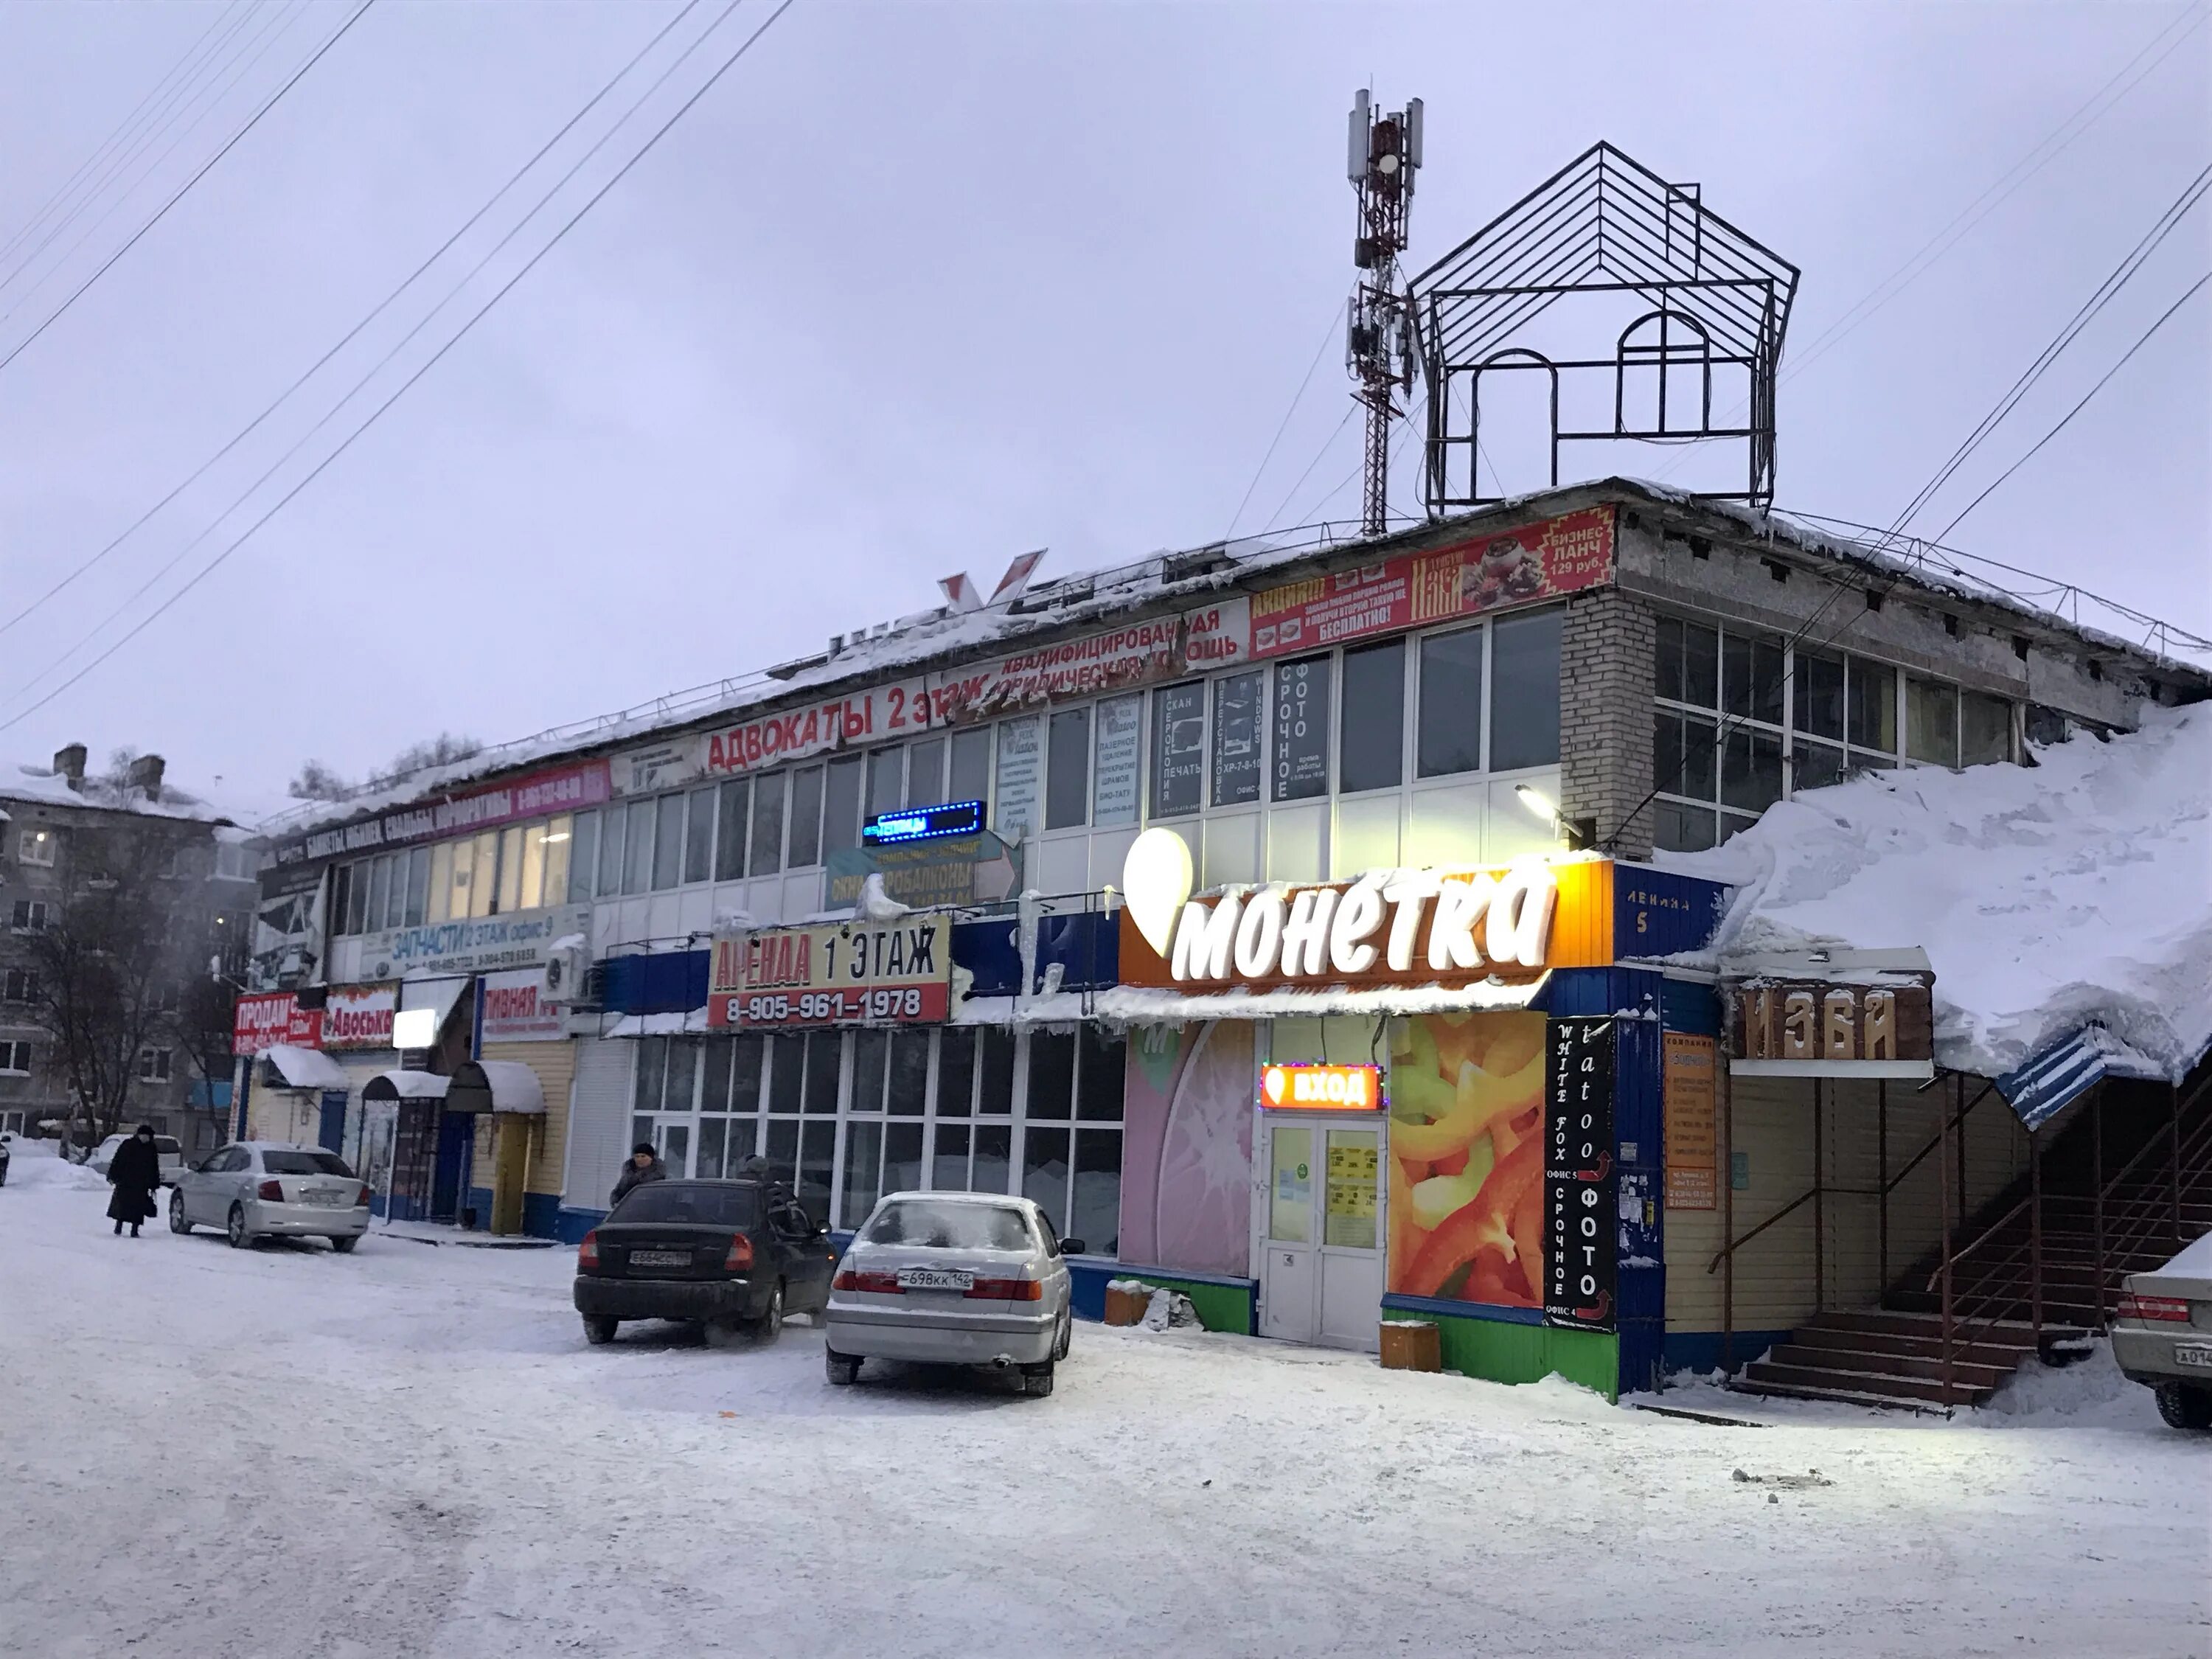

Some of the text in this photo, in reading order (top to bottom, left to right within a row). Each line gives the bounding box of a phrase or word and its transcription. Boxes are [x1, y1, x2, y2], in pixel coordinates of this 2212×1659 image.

[1551, 526, 1604, 546] БИЗНЕС
[1553, 540, 1601, 562] ЛАНЧ
[1551, 557, 1603, 575] 129 руб.
[1320, 605, 1391, 641] БЕСПЛАТНО!
[1166, 697, 1192, 711] СКАН
[1254, 676, 1263, 744] WINDOWS
[1294, 662, 1309, 737] ФОТО
[708, 695, 872, 772] АДВОКАТЫ
[888, 686, 906, 728] 2
[1163, 689, 1172, 801] КСЕРОКОПИЯ
[1215, 681, 1225, 804] ПЕРЕУСТАНОВКА
[1278, 665, 1291, 798] СРОЧНОЕ
[1164, 763, 1201, 779] ПЕЧАТЬ
[1637, 911, 1648, 933] 5
[392, 924, 465, 960] ЗАПЧАСТИ
[475, 922, 509, 946] ЭТАЖ
[824, 937, 836, 979] 1
[850, 926, 937, 979] ЭТАЖ
[237, 998, 290, 1032] ПРОДАМ
[726, 989, 922, 1023] 8-905-961-1978
[1666, 1037, 1712, 1047] КОМПАНИЯ
[1294, 1071, 1366, 1106] ВХОД
[1555, 1024, 1573, 1161] WHITE FOX
[1581, 1024, 1595, 1158] tatoo
[1547, 1170, 1577, 1180] ОФИС 5
[1555, 1187, 1565, 1295] СРОЧНОЕ
[1580, 1188, 1598, 1295] ФОТО
[1545, 1304, 1576, 1316] ОФИС 4
